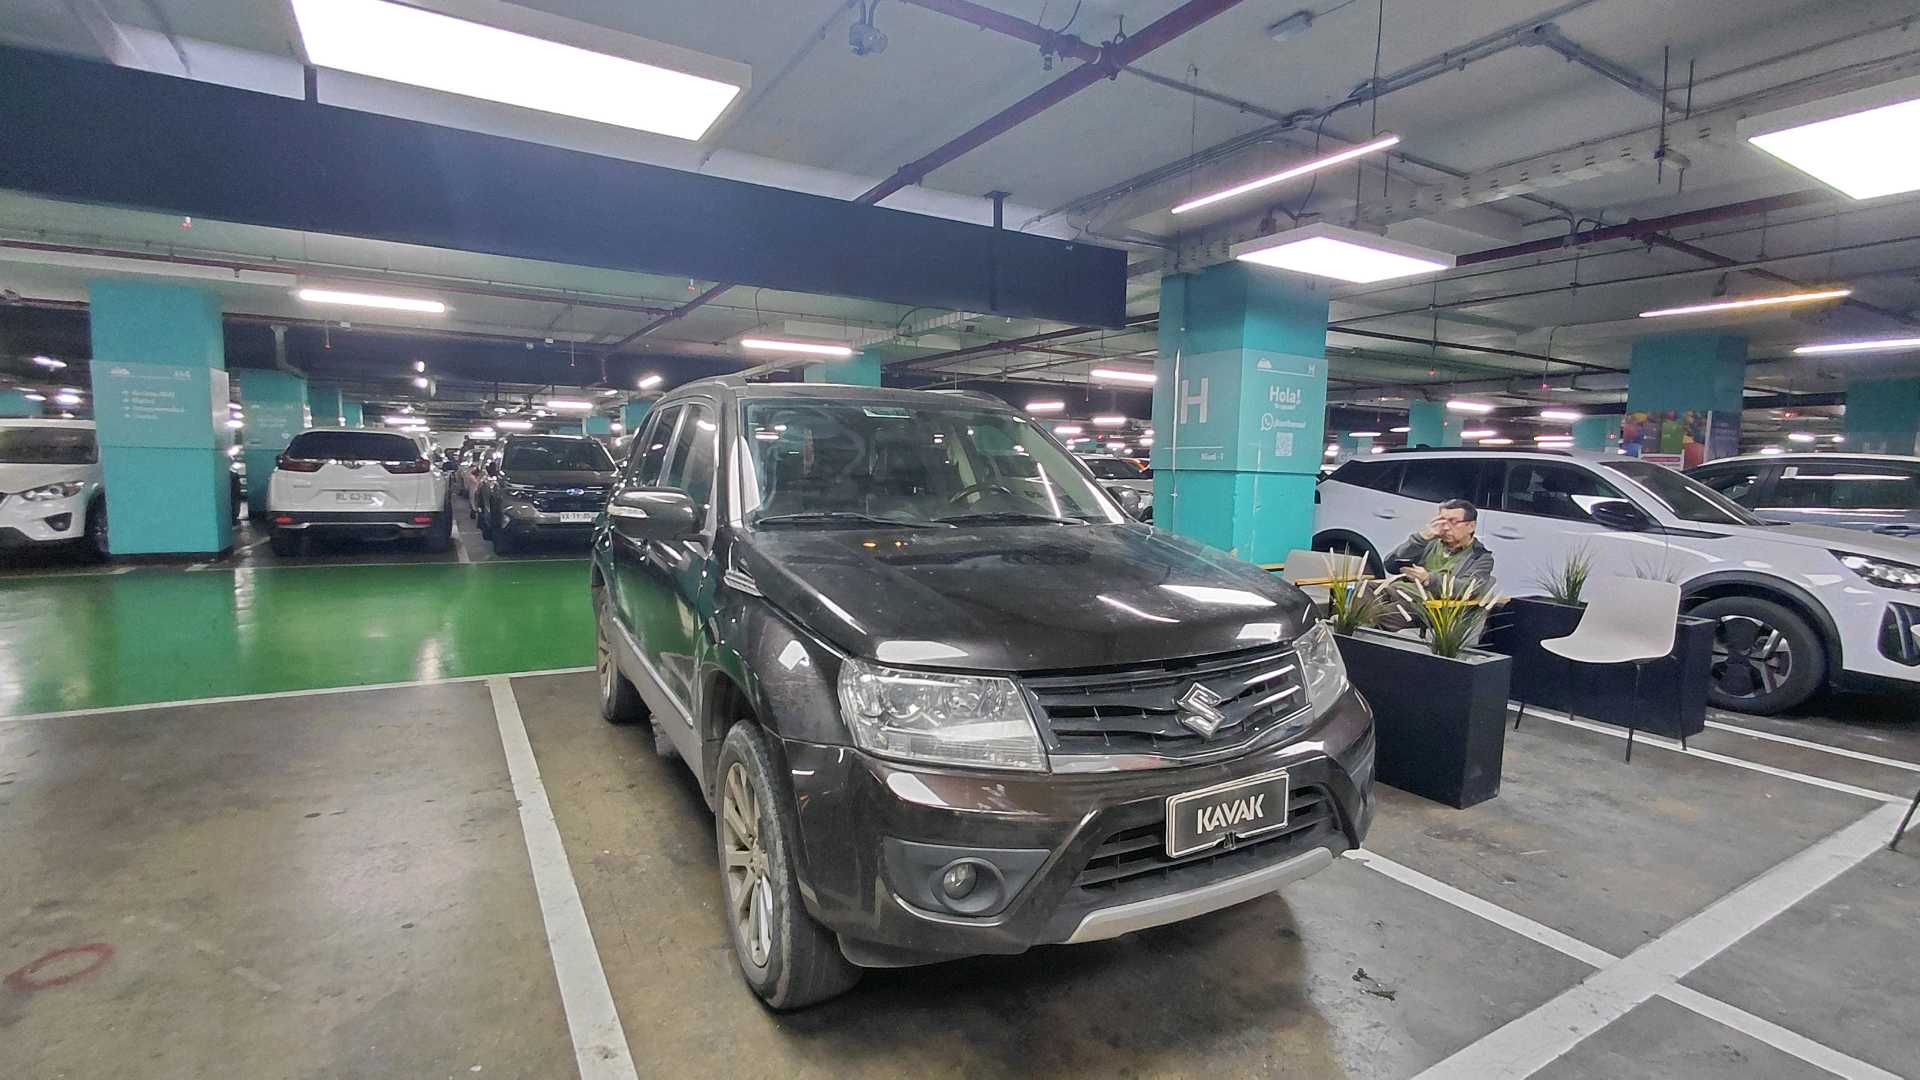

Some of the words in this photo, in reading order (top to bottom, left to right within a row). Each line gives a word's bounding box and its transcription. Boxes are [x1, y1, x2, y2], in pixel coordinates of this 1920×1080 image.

[1180, 377, 1209, 425] H
[1269, 385, 1302, 406] Hola!
[1197, 793, 1265, 835] KAVAK
